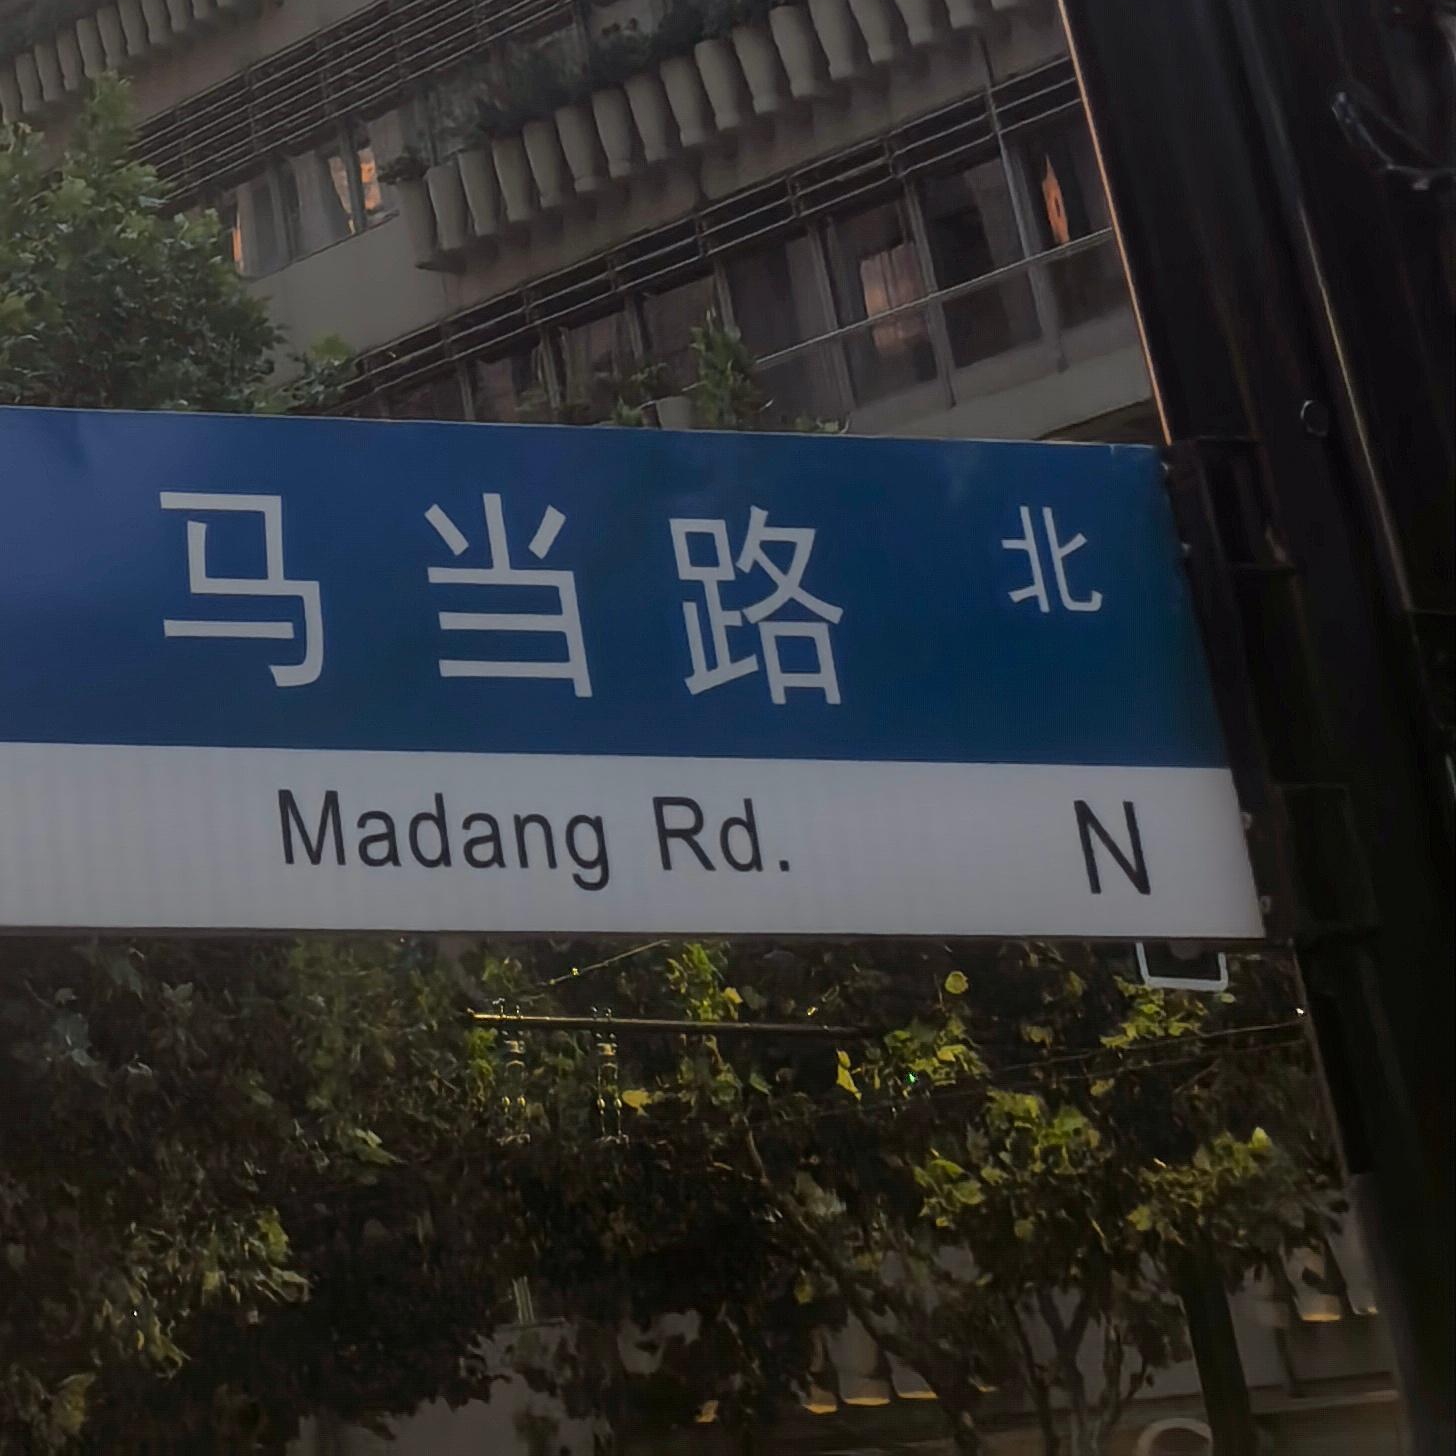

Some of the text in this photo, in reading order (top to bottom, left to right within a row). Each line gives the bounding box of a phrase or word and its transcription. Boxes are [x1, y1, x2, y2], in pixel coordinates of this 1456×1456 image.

[159, 491, 844, 705] 马当路
[1001, 505, 1104, 614] 北
[277, 789, 610, 892] Madang
[652, 796, 791, 873] Rd.
[1073, 799, 1152, 896] N
